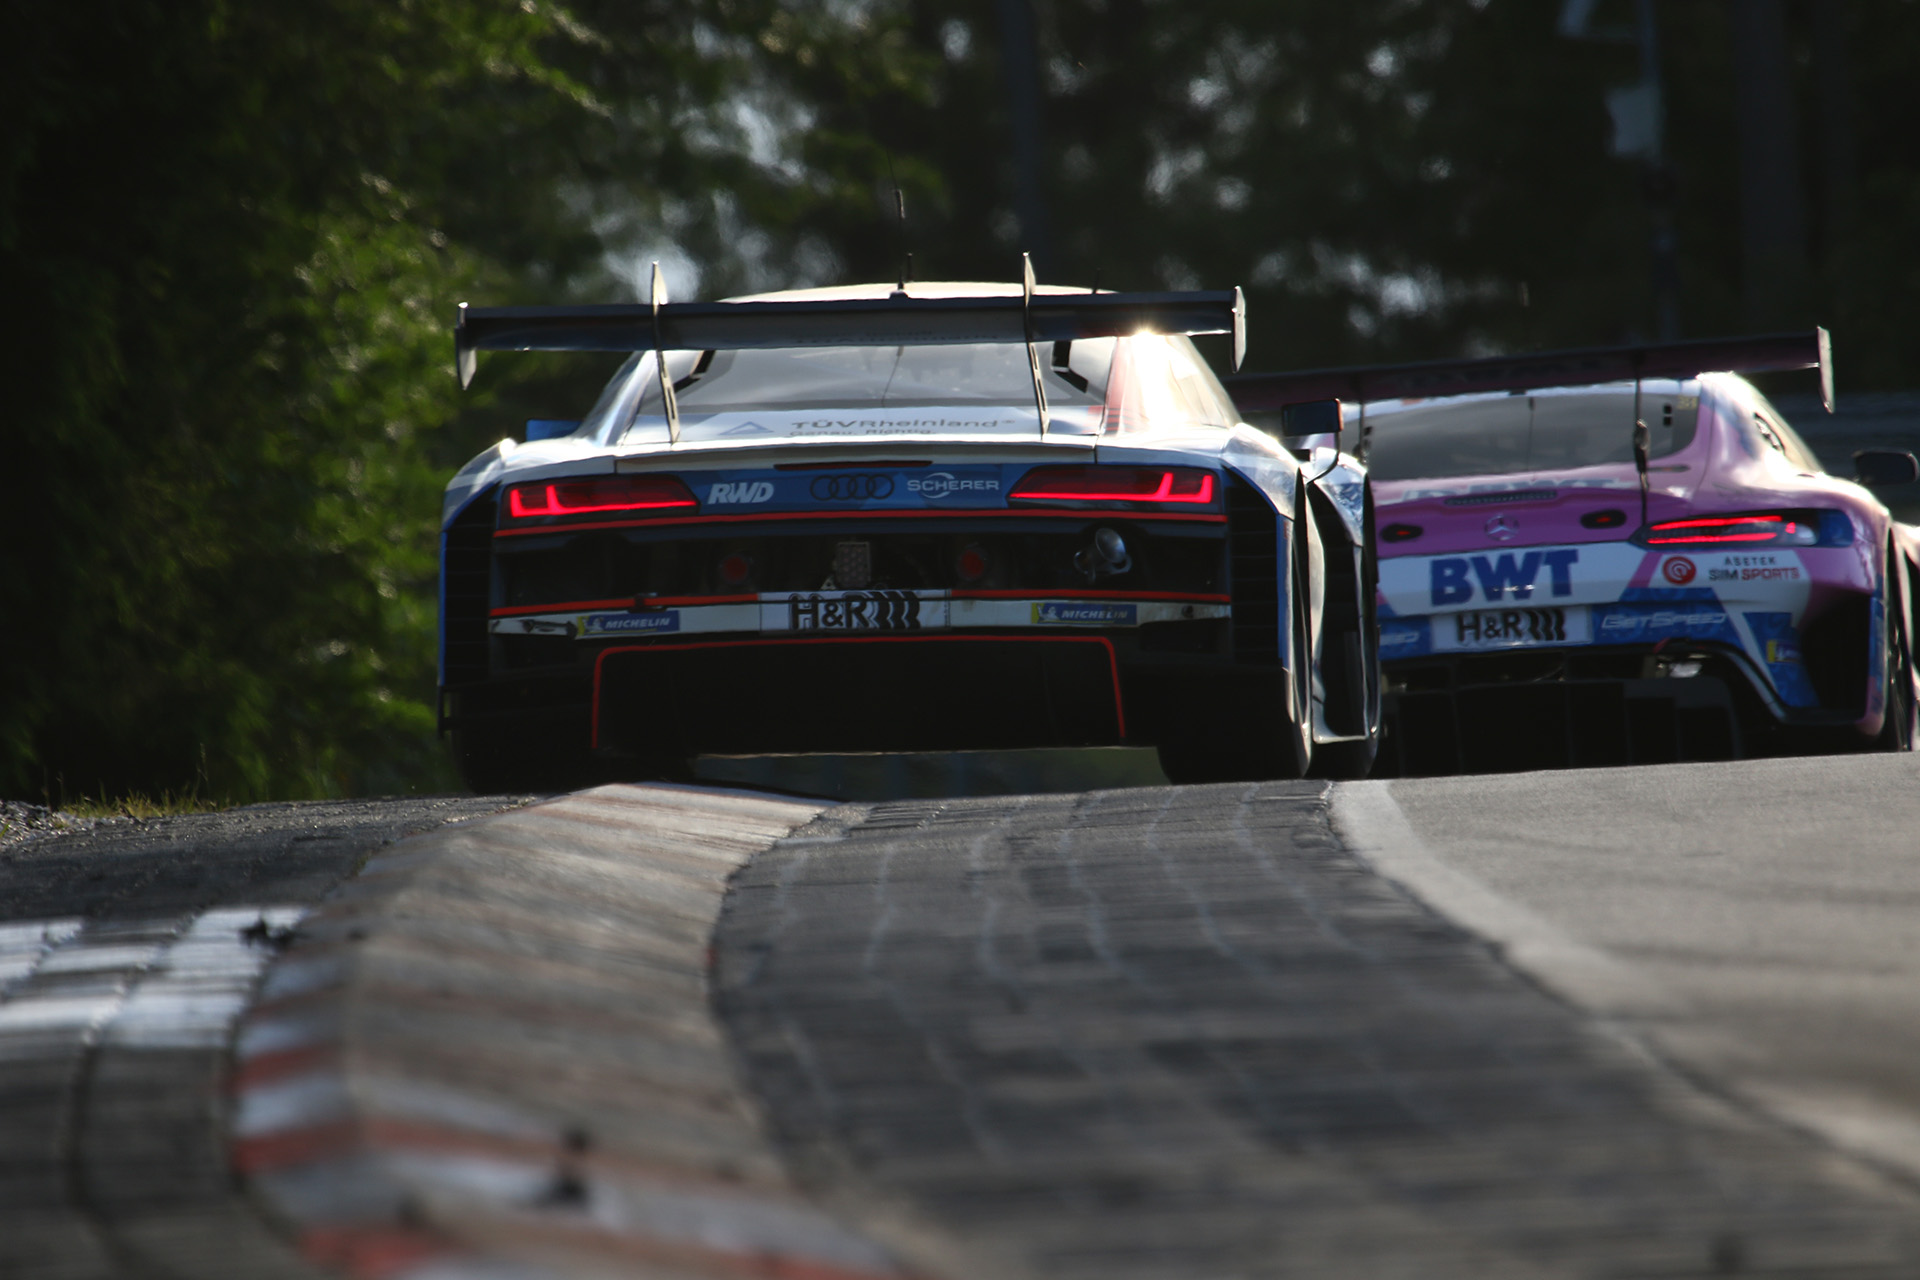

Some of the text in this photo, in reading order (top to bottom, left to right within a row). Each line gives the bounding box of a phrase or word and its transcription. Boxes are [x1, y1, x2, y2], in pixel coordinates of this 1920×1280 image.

[907, 479, 1000, 492] SCHERER
[707, 482, 774, 505] RWD
[1724, 556, 1776, 566] ASETEK
[1430, 549, 1579, 606] BWT
[1709, 567, 1800, 581] SIM SPORTS
[1061, 609, 1128, 620] MICHELIN
[604, 617, 671, 629] MICHELIN
